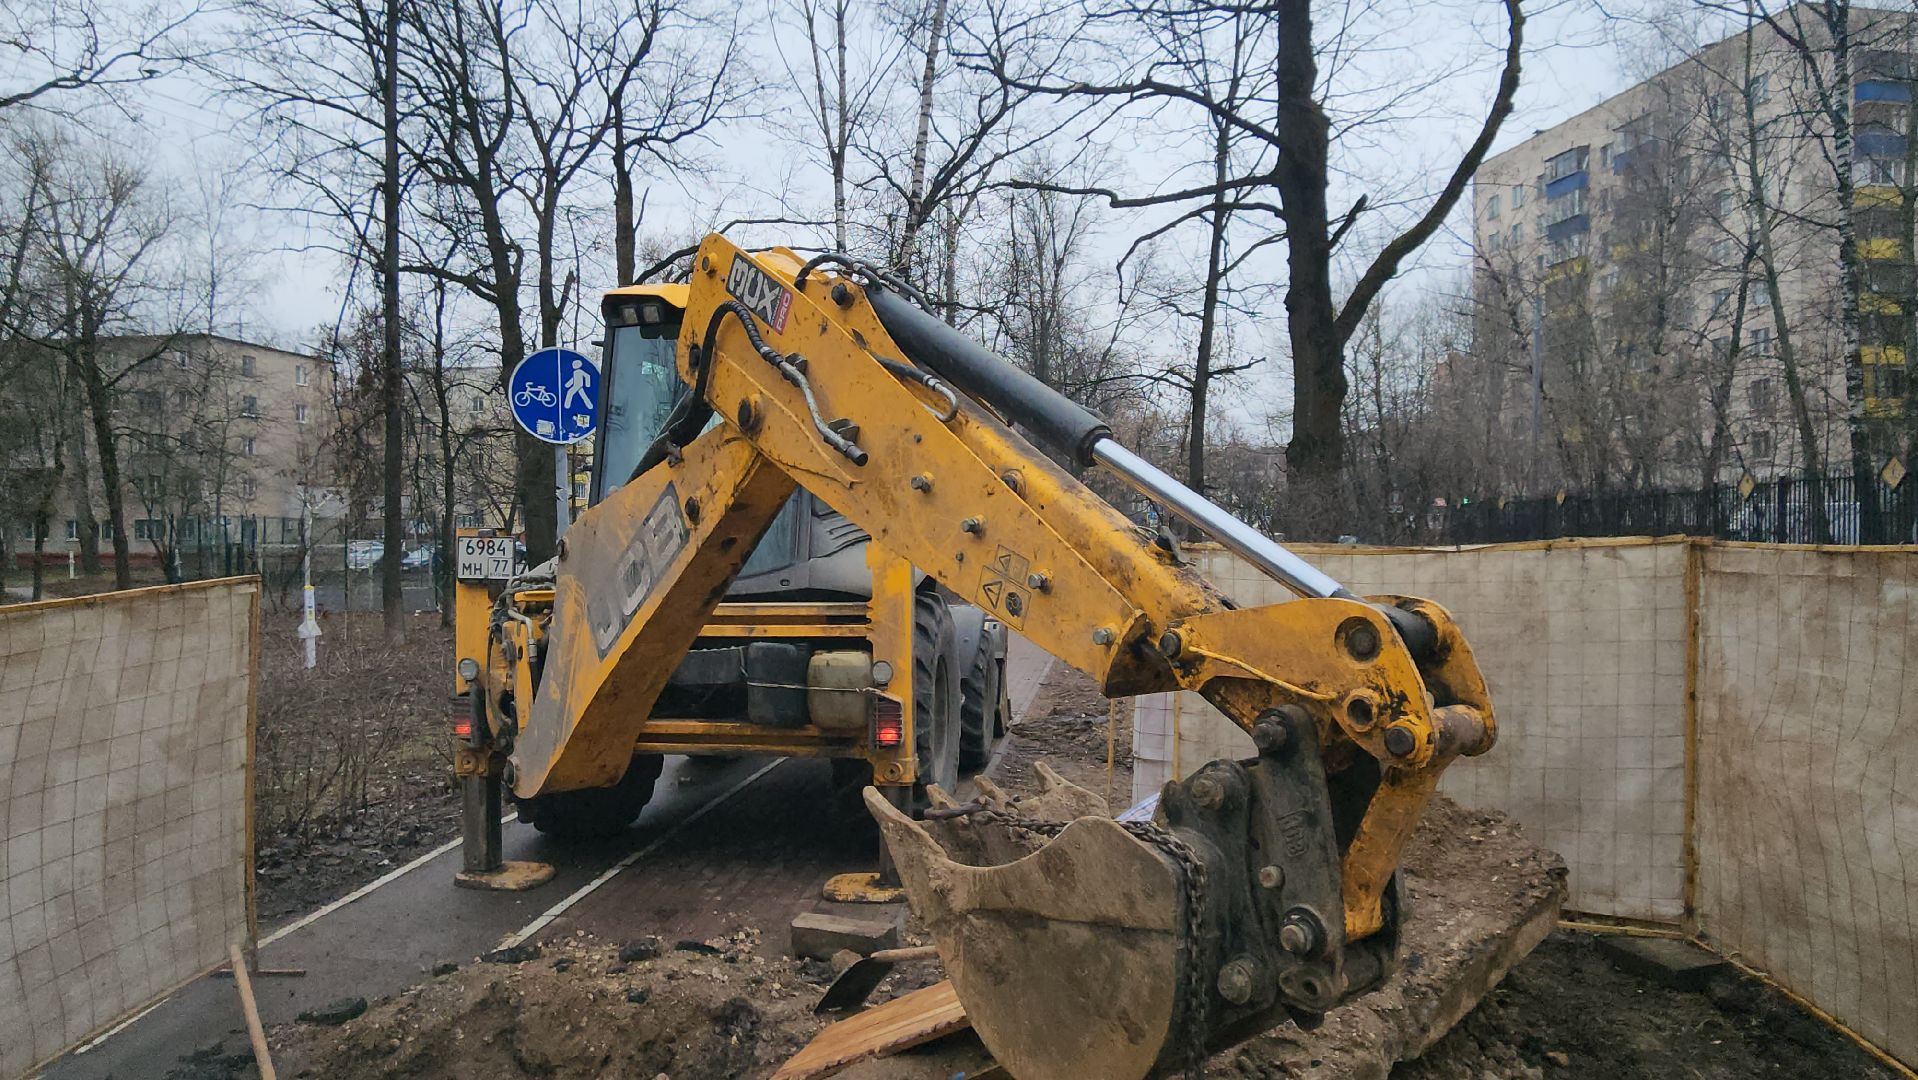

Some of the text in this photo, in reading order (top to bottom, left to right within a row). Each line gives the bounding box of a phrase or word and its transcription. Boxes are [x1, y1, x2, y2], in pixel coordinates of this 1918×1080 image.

[775, 292, 792, 331] PRO
[465, 539, 506, 556] 6984
[492, 559, 509, 573] 77
[597, 495, 683, 650] JCB
